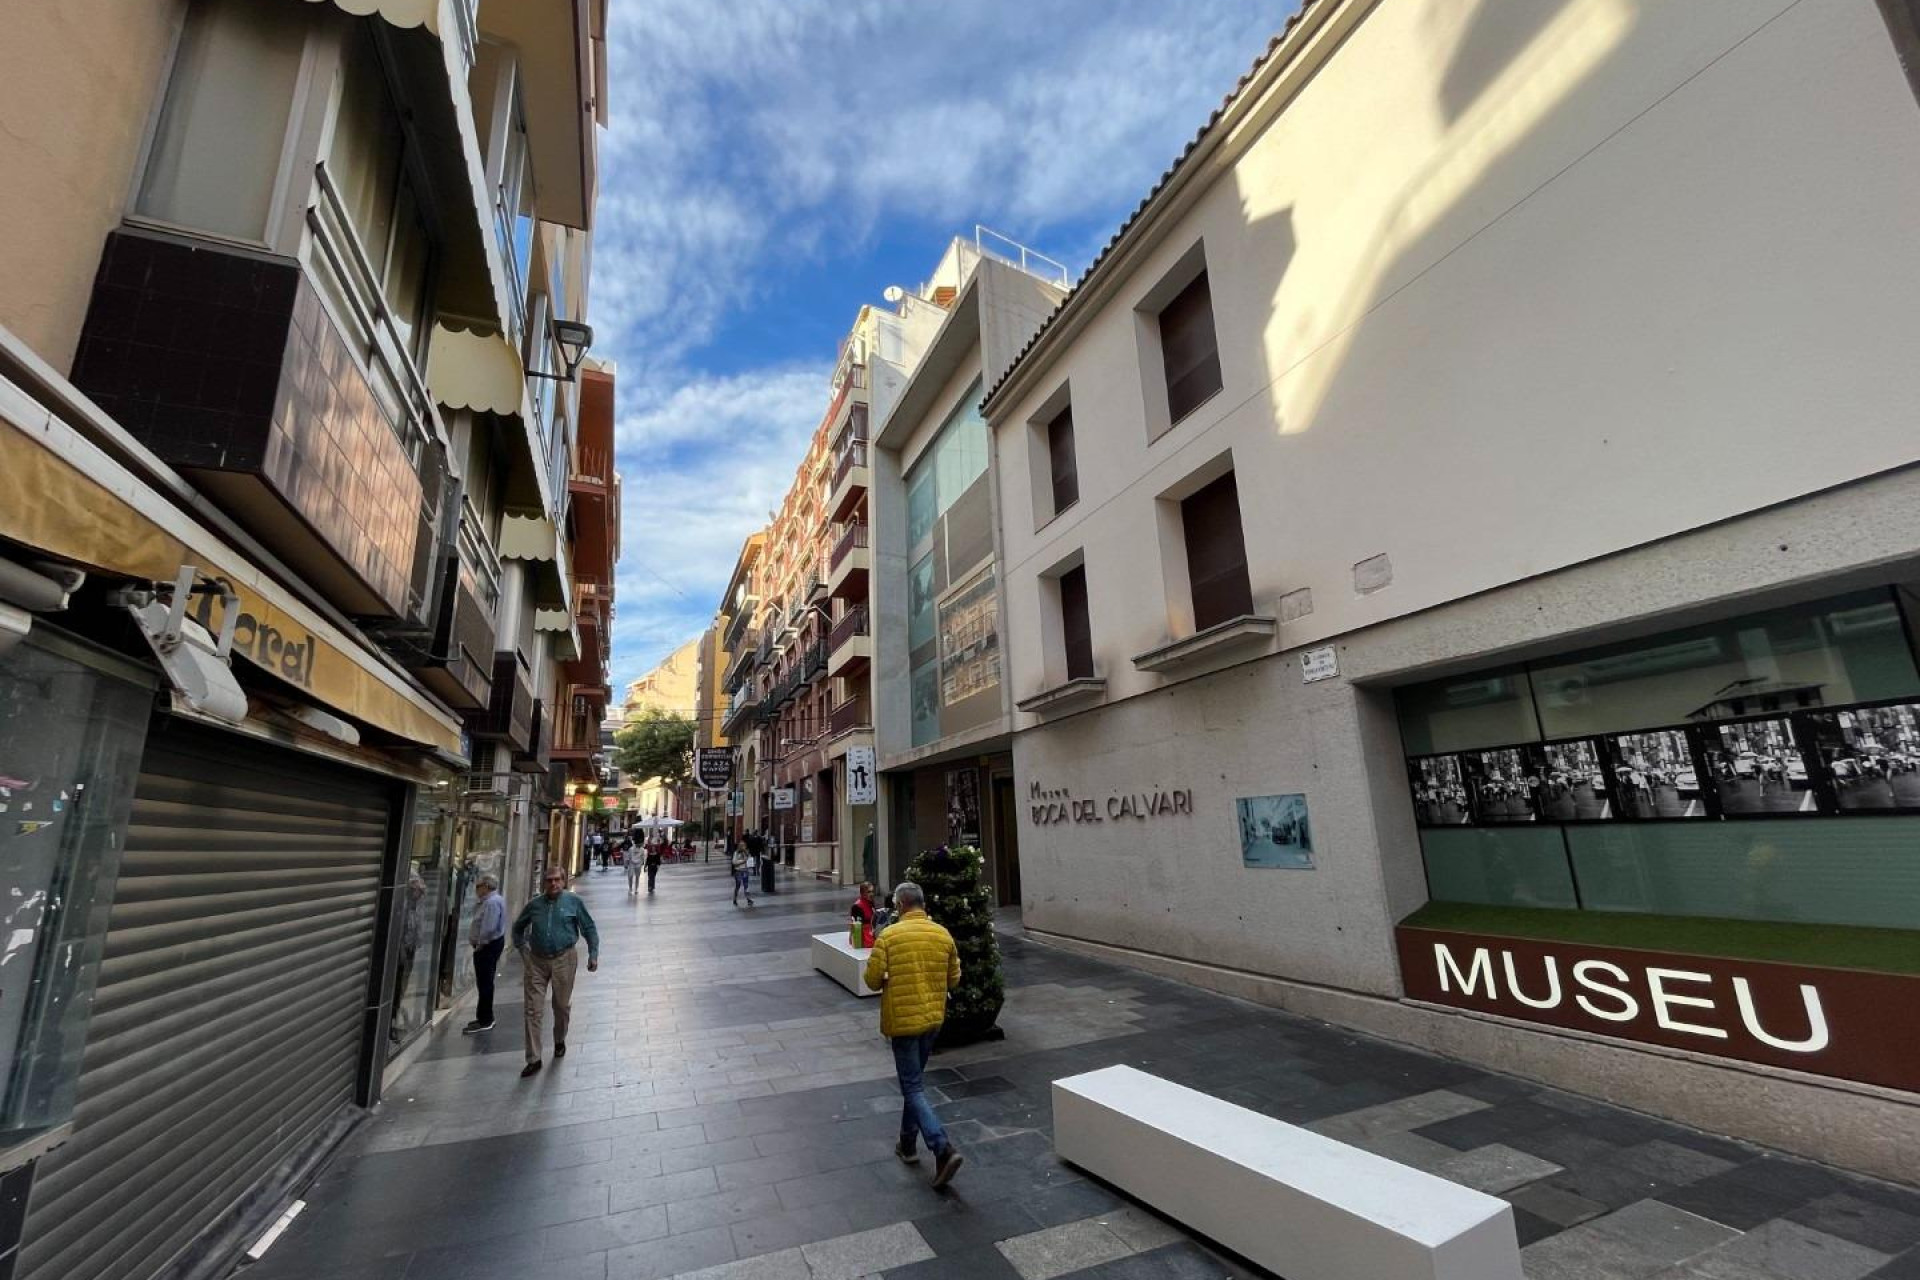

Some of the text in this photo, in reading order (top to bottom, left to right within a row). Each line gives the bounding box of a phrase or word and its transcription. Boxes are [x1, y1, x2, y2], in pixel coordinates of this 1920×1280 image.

[1031, 788, 1193, 826] BOCA DEL CALVARI
[1433, 943, 1829, 1053] MUSEU
